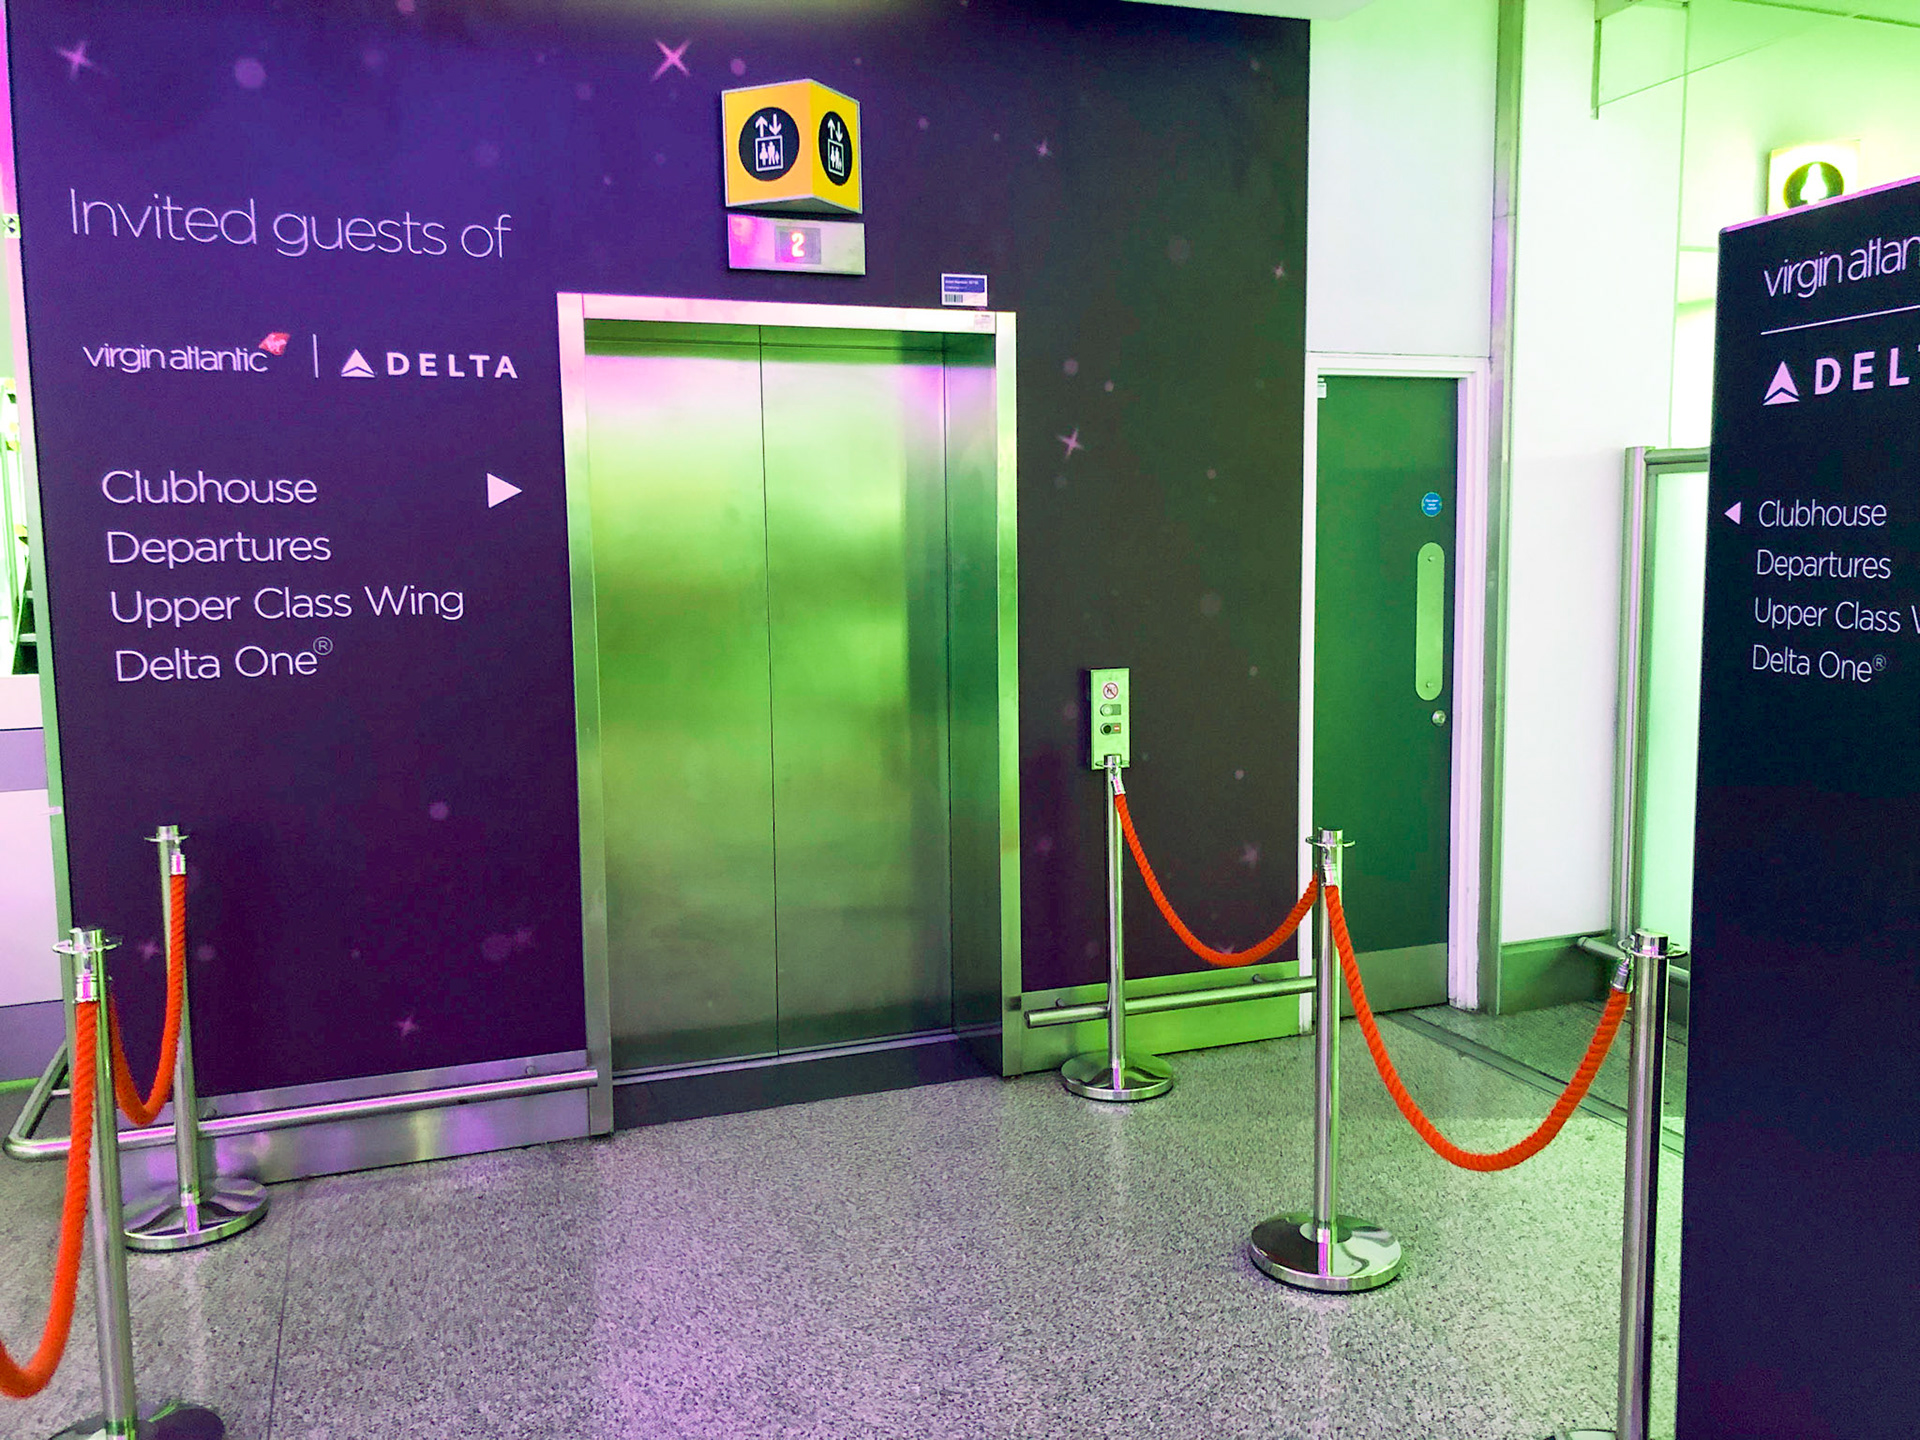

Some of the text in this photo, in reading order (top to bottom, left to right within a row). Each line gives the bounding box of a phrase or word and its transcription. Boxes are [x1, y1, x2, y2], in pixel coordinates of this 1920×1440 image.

[71, 188, 512, 257] Invited guests of
[791, 231, 804, 257] 2
[1763, 251, 1843, 298] virgin
[83, 343, 518, 379] virgin atlantic DELTA
[1814, 345, 1920, 395] DEL
[101, 470, 318, 504] Clubhouse
[1758, 499, 1887, 528] Clubhouse
[107, 531, 332, 569] Departures
[1756, 550, 1892, 581] Departures
[111, 585, 464, 628] Upper Class Wing
[1755, 597, 1828, 630] Upper
[1835, 601, 1901, 633] Class
[115, 648, 220, 682] Delta
[1752, 644, 1810, 676] Delta
